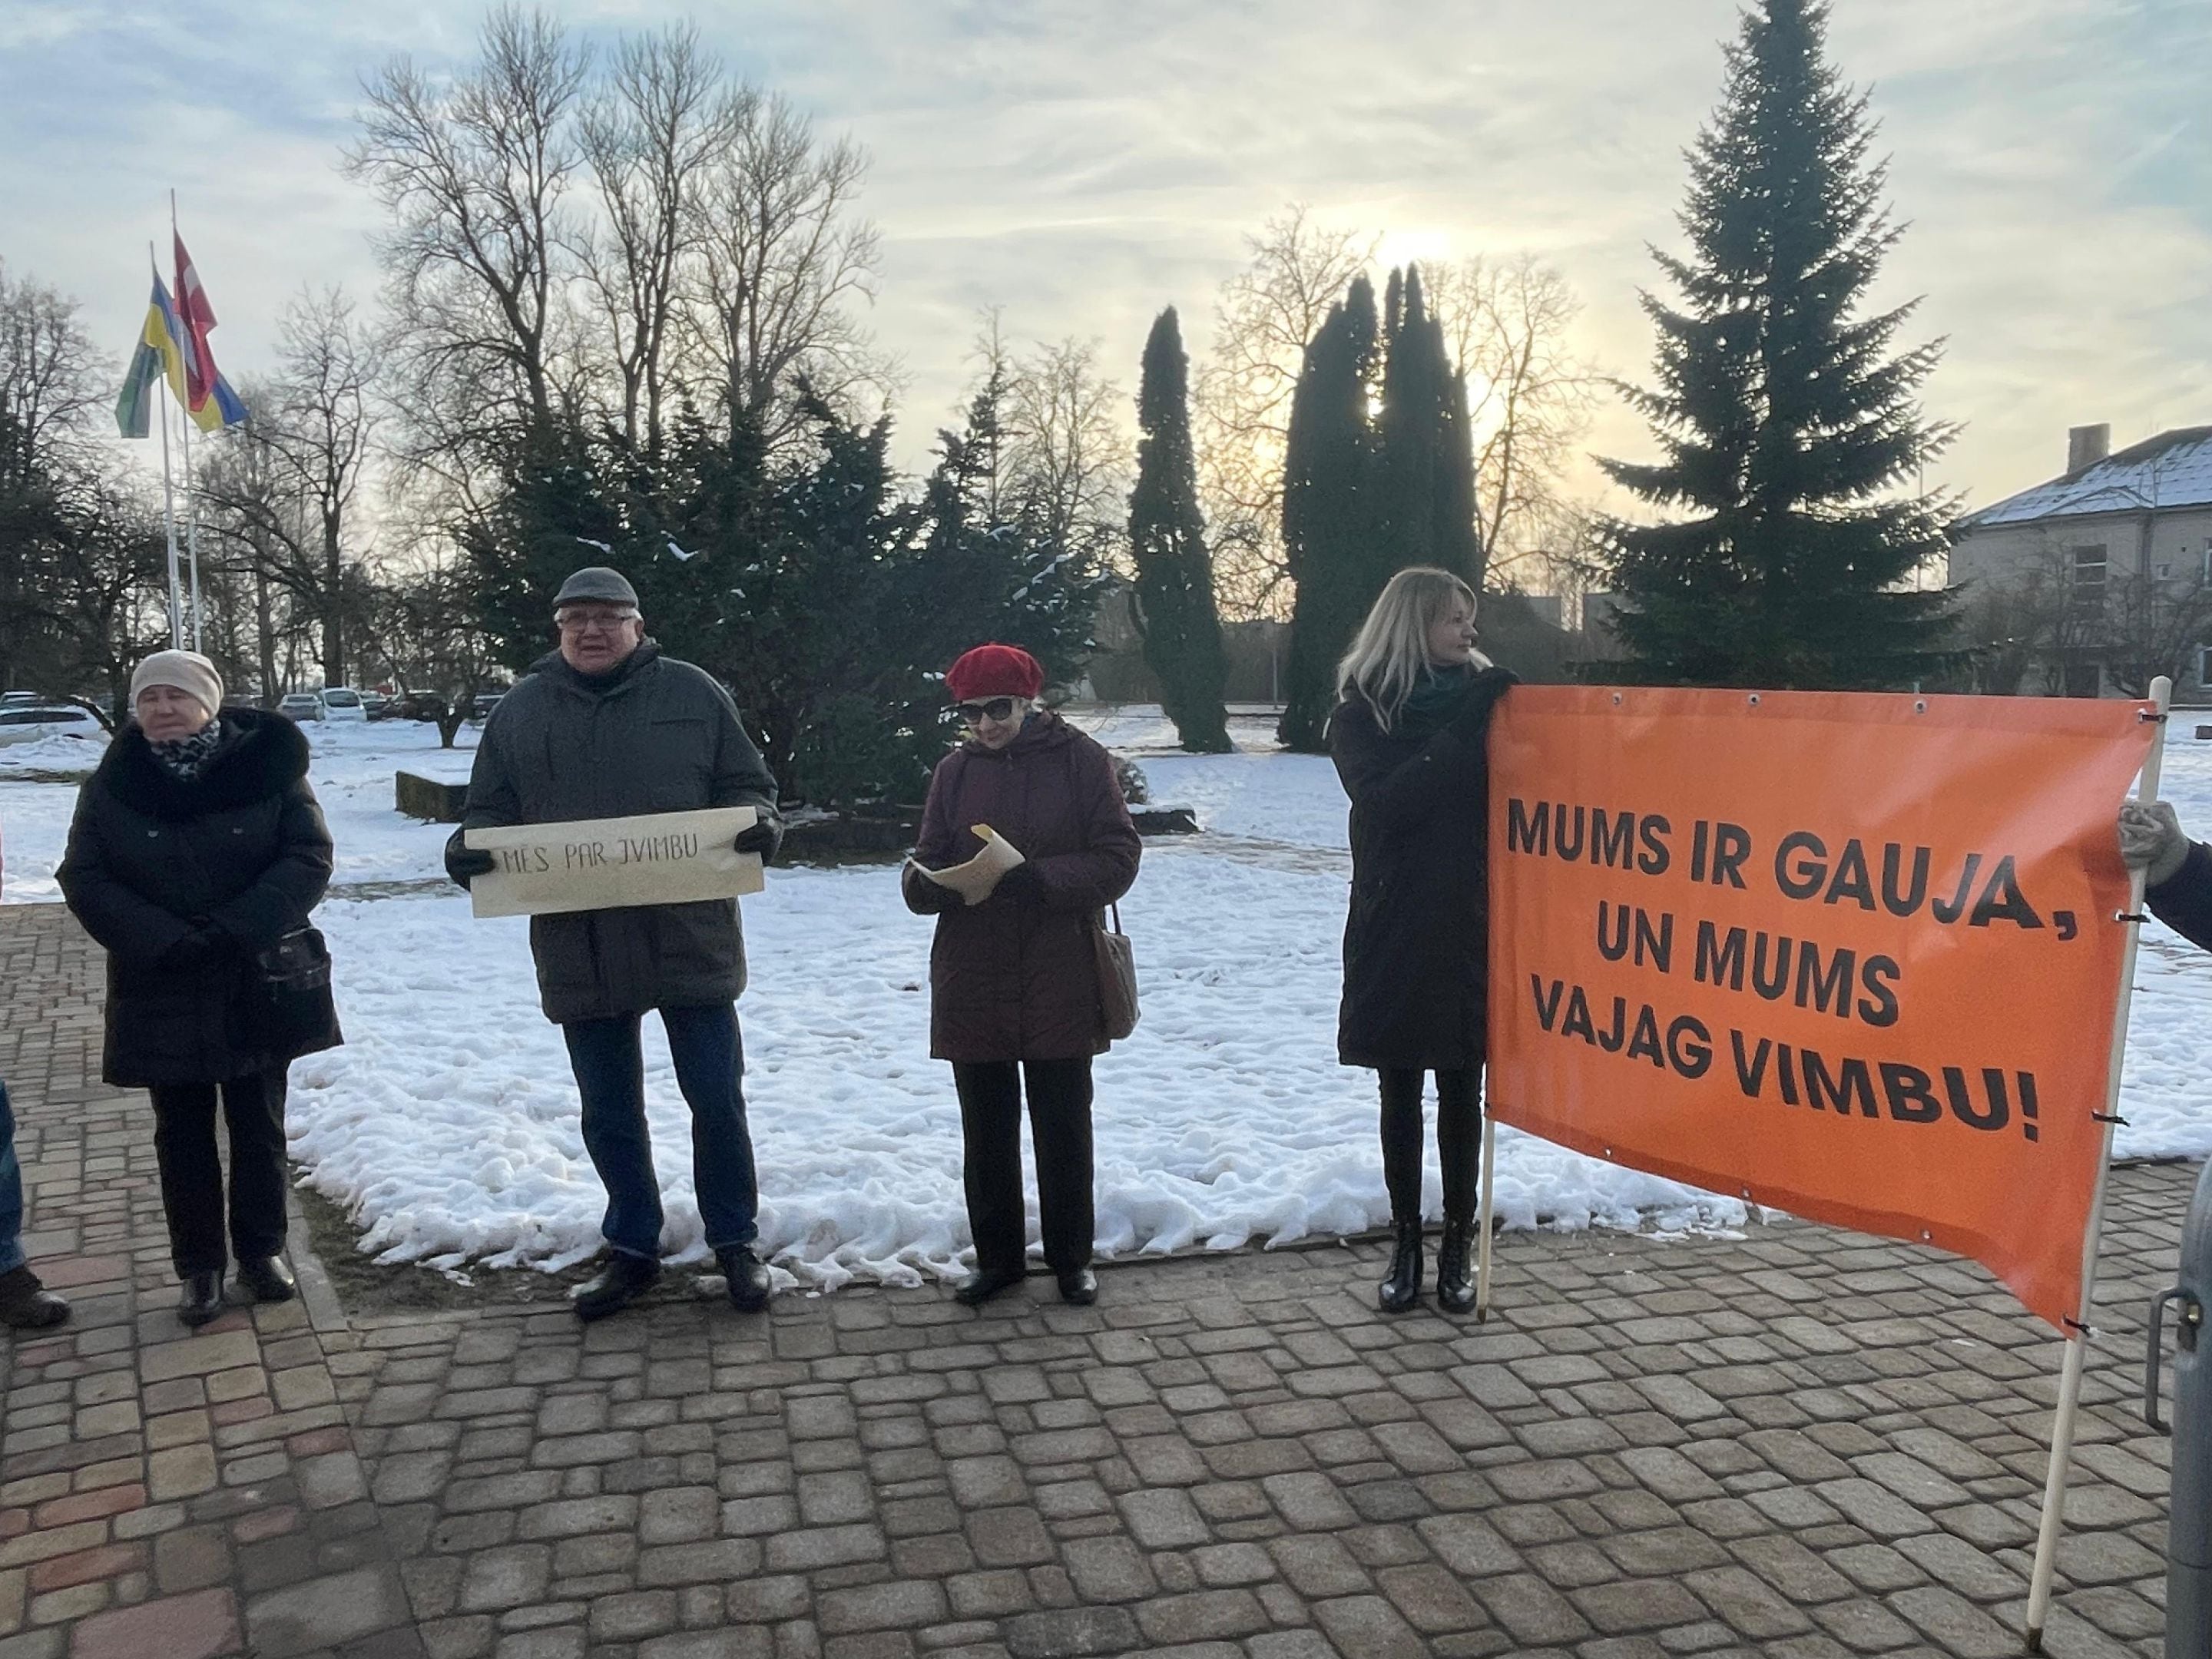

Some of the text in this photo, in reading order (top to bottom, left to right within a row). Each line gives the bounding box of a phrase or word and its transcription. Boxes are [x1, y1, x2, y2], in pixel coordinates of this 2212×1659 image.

[565, 842, 608, 869] PAR
[1508, 798, 2078, 941] MUMS IR GAUJA,
[1598, 900, 1901, 1028] UN MUMS
[1532, 974, 2039, 1143] VAJAG VIMBU!
